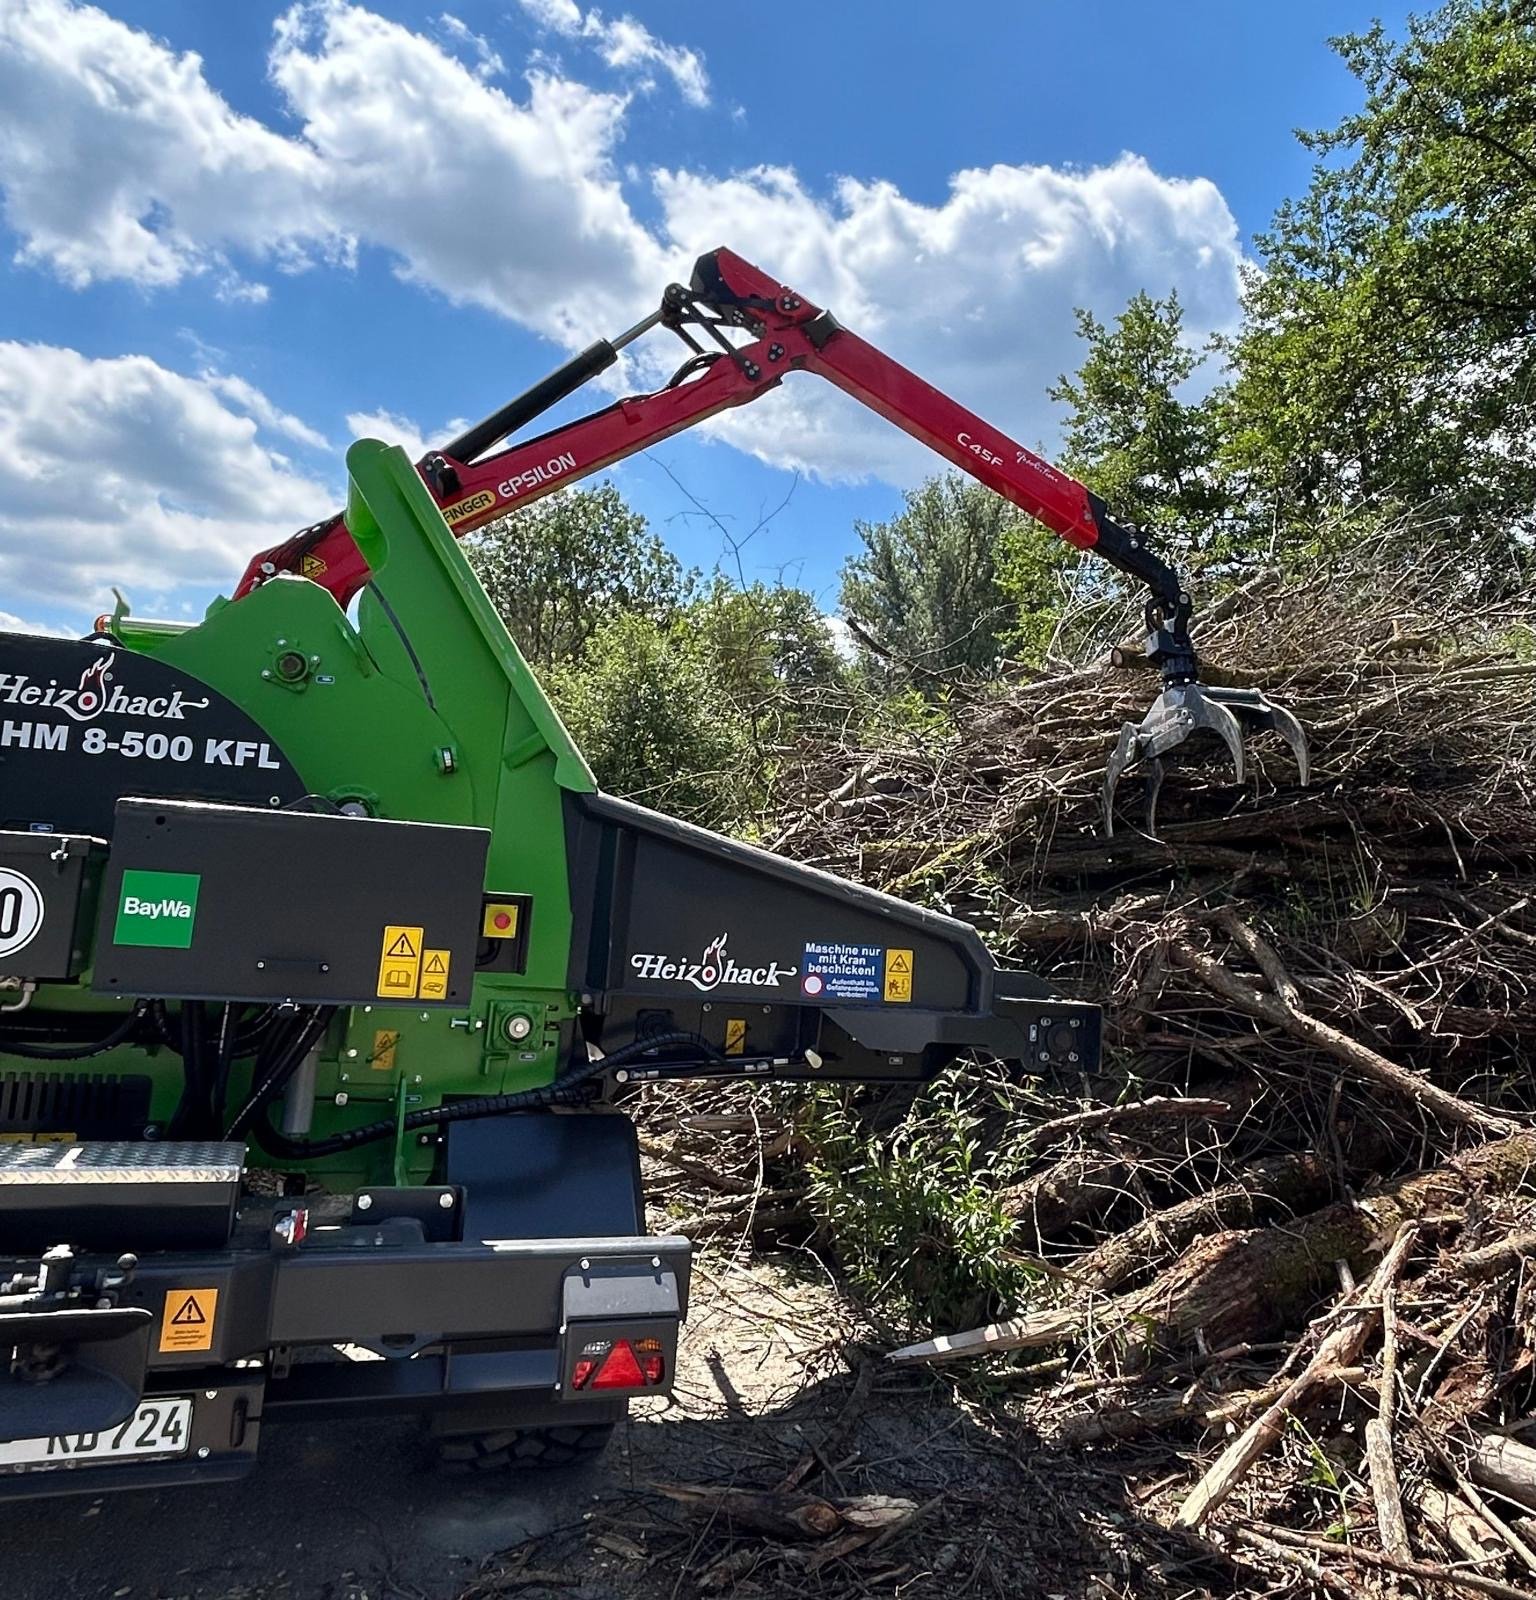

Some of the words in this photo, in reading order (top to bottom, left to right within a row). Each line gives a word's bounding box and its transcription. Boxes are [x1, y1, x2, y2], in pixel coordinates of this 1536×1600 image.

[497, 451, 577, 498] EPSILON
[443, 493, 492, 524] FINGER
[1, 720, 69, 751] HM
[82, 728, 193, 762] 8-500
[204, 738, 280, 769] KFL
[123, 896, 192, 920] BayWa
[805, 942, 859, 955] Maschine
[861, 947, 881, 956] nur
[807, 962, 876, 976] beschicken!
[818, 954, 837, 964] mit
[839, 954, 866, 965] Kran
[831, 978, 865, 986] Aufenthalt
